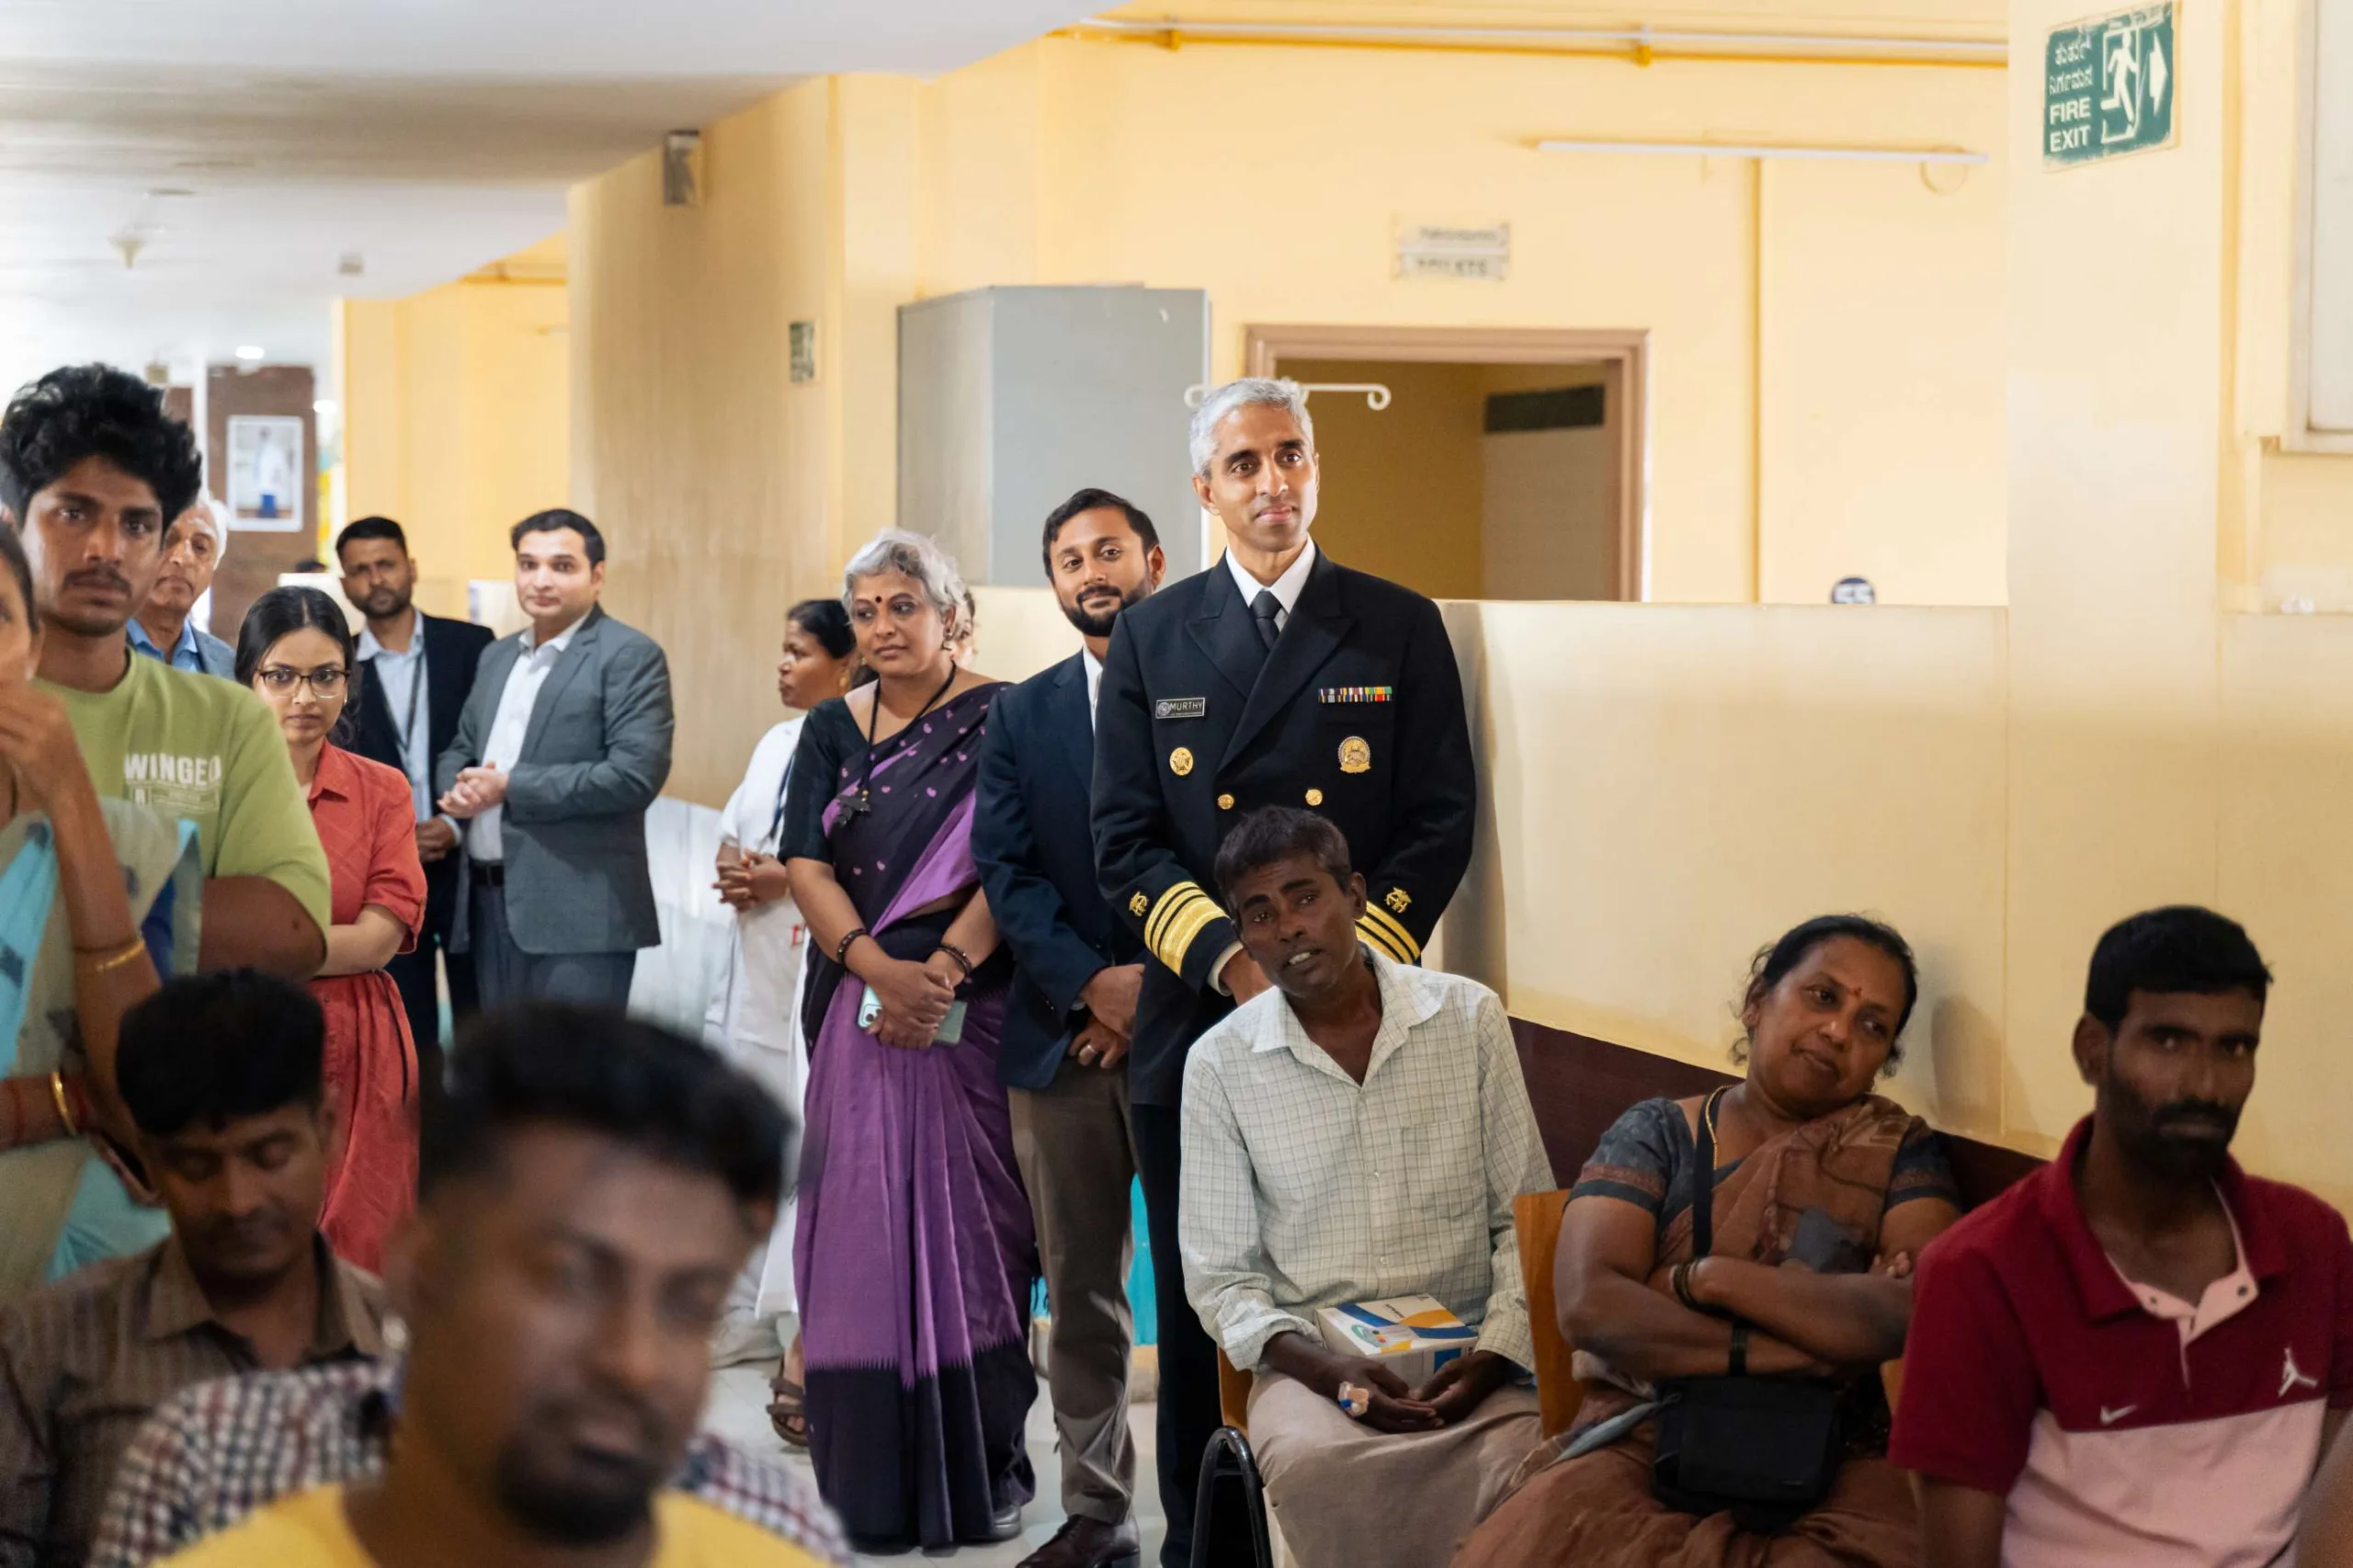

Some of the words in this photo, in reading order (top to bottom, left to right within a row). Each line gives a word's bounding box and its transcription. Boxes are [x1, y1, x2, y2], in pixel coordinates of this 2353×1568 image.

[2050, 97, 2091, 125] FIRE
[2050, 125, 2091, 153] EXIT
[1169, 701, 1203, 711] MURTHY
